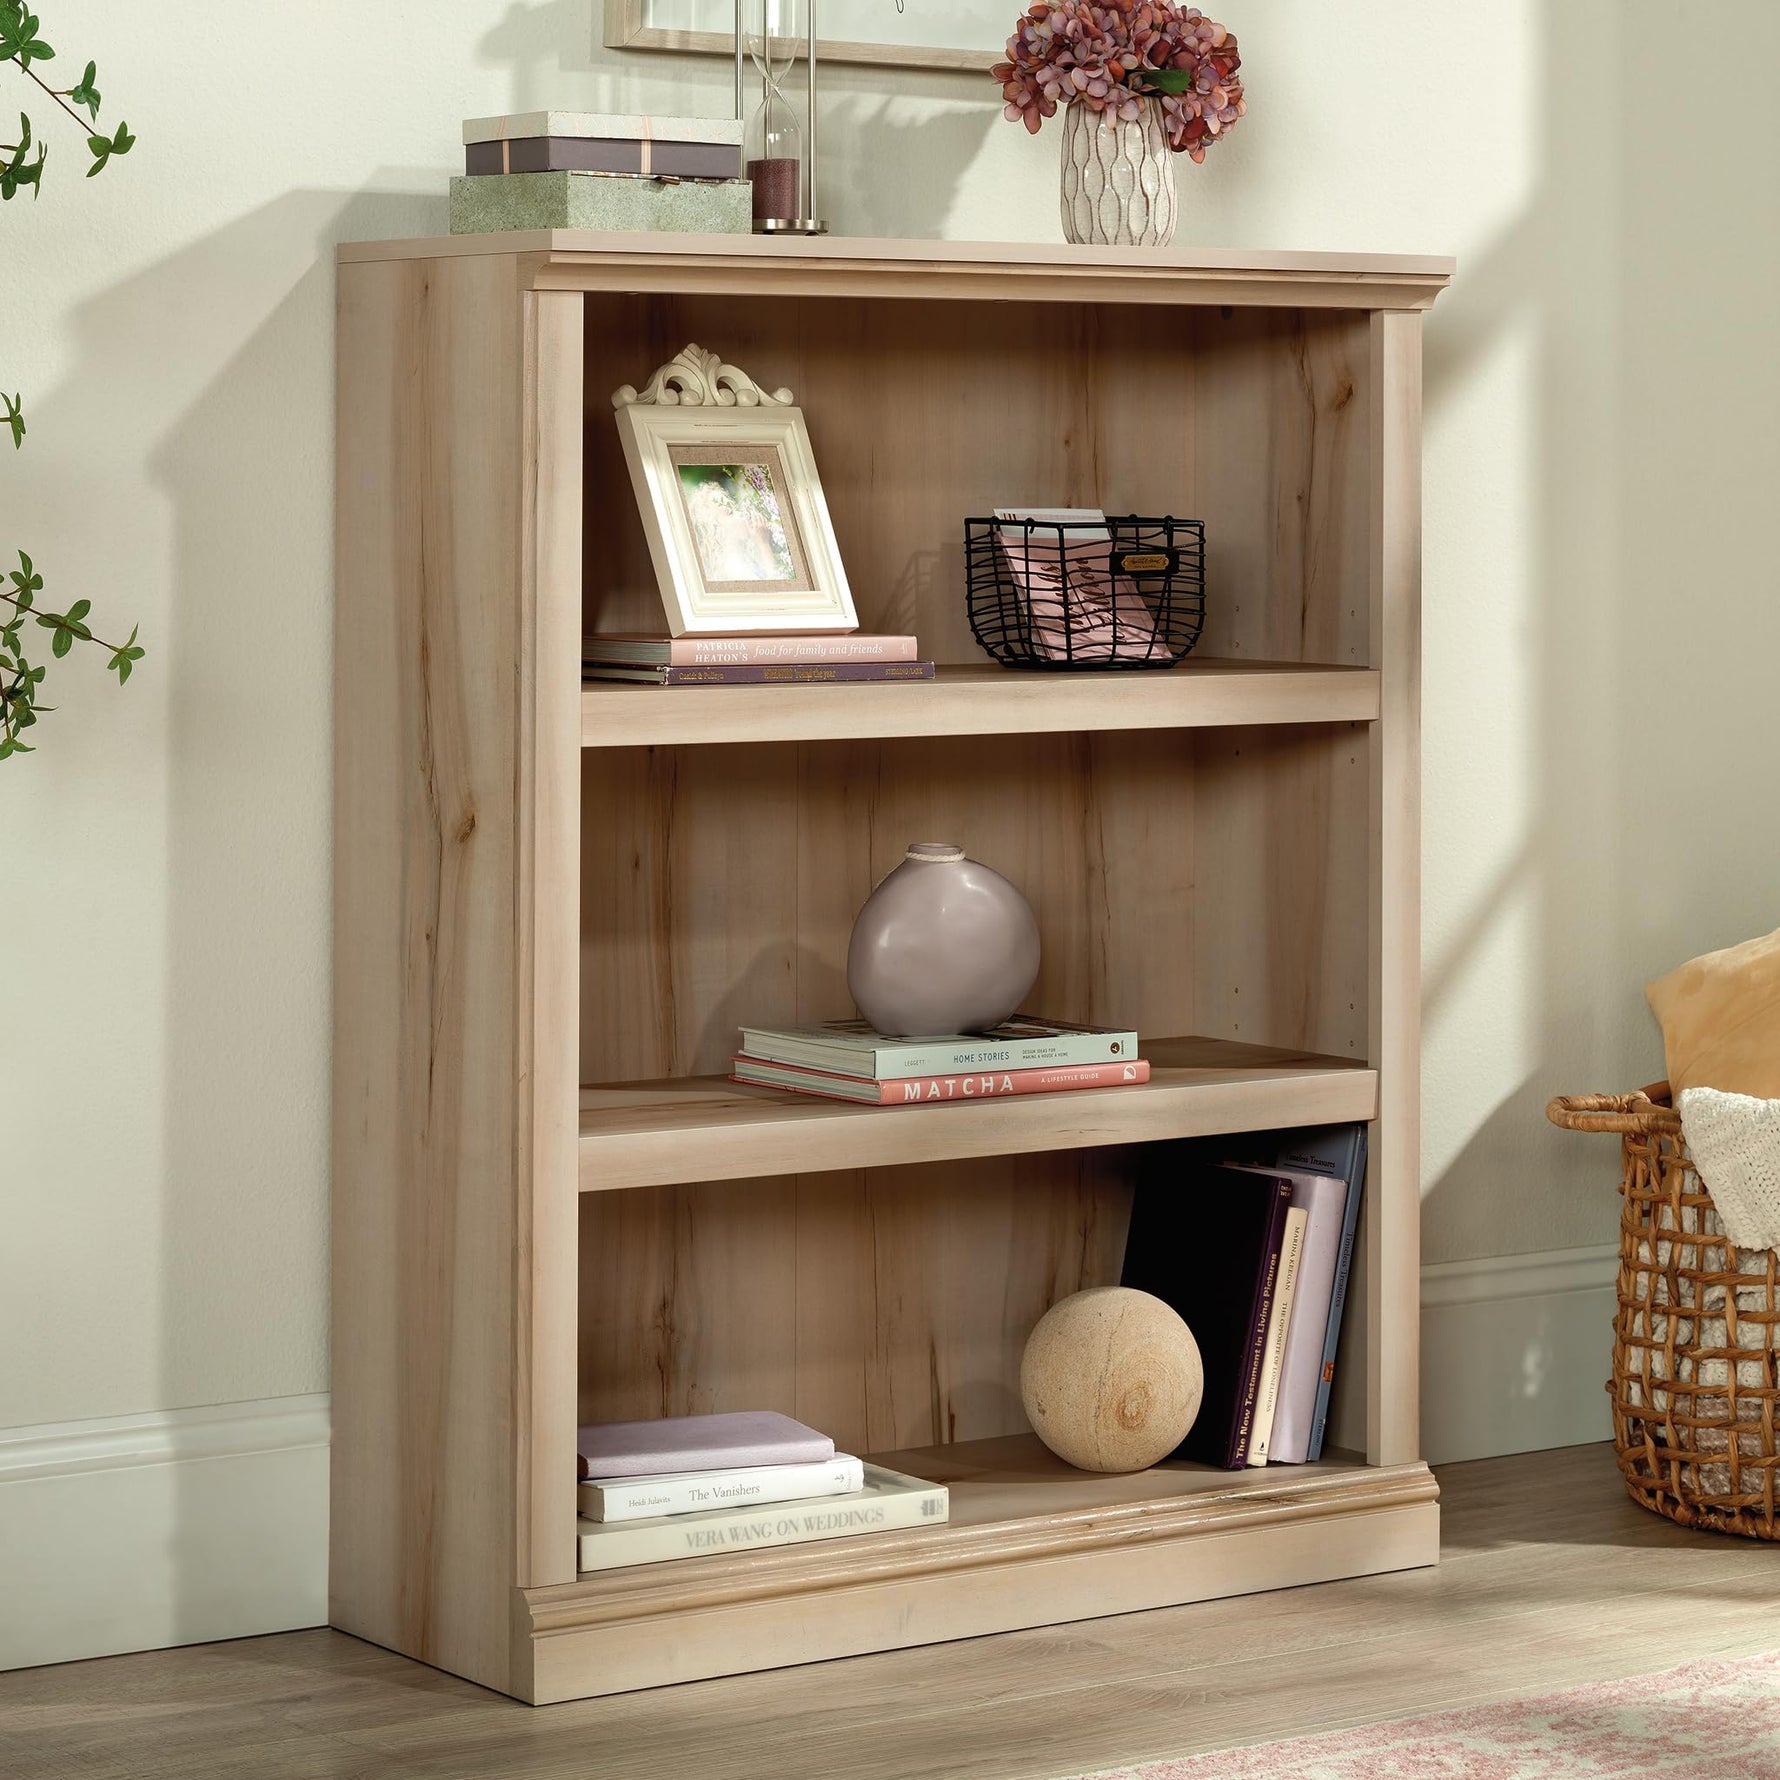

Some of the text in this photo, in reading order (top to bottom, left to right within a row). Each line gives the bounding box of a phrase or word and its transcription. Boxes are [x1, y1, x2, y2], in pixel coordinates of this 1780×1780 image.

[695, 641, 747, 651] PATRICIA
[754, 643, 883, 658] food for family and friends
[694, 652, 748, 663] HEATON'S
[904, 1059, 925, 1067] LEGGETT
[953, 1051, 1010, 1064] HOME STORIES
[1047, 1074, 1078, 1083] LIFESTYLE
[904, 1075, 1014, 1101] MATCHA
[1309, 1154, 1336, 1168] Treasures
[1285, 1226, 1300, 1291] MARINA KEEGAN
[1335, 1231, 1353, 1308] Timeless Treasures
[1275, 1318, 1285, 1354] OPPOSITE
[1236, 1253, 1277, 1459] The New Testament in Living Pictures
[1273, 1355, 1280, 1367] OF
[1266, 1367, 1278, 1412] LONELINESS
[688, 1483, 761, 1502] The Vanishers
[628, 1495, 671, 1508] Heidi Julavits
[685, 1507, 885, 1549] VERA WANG ON WEDDINGS
